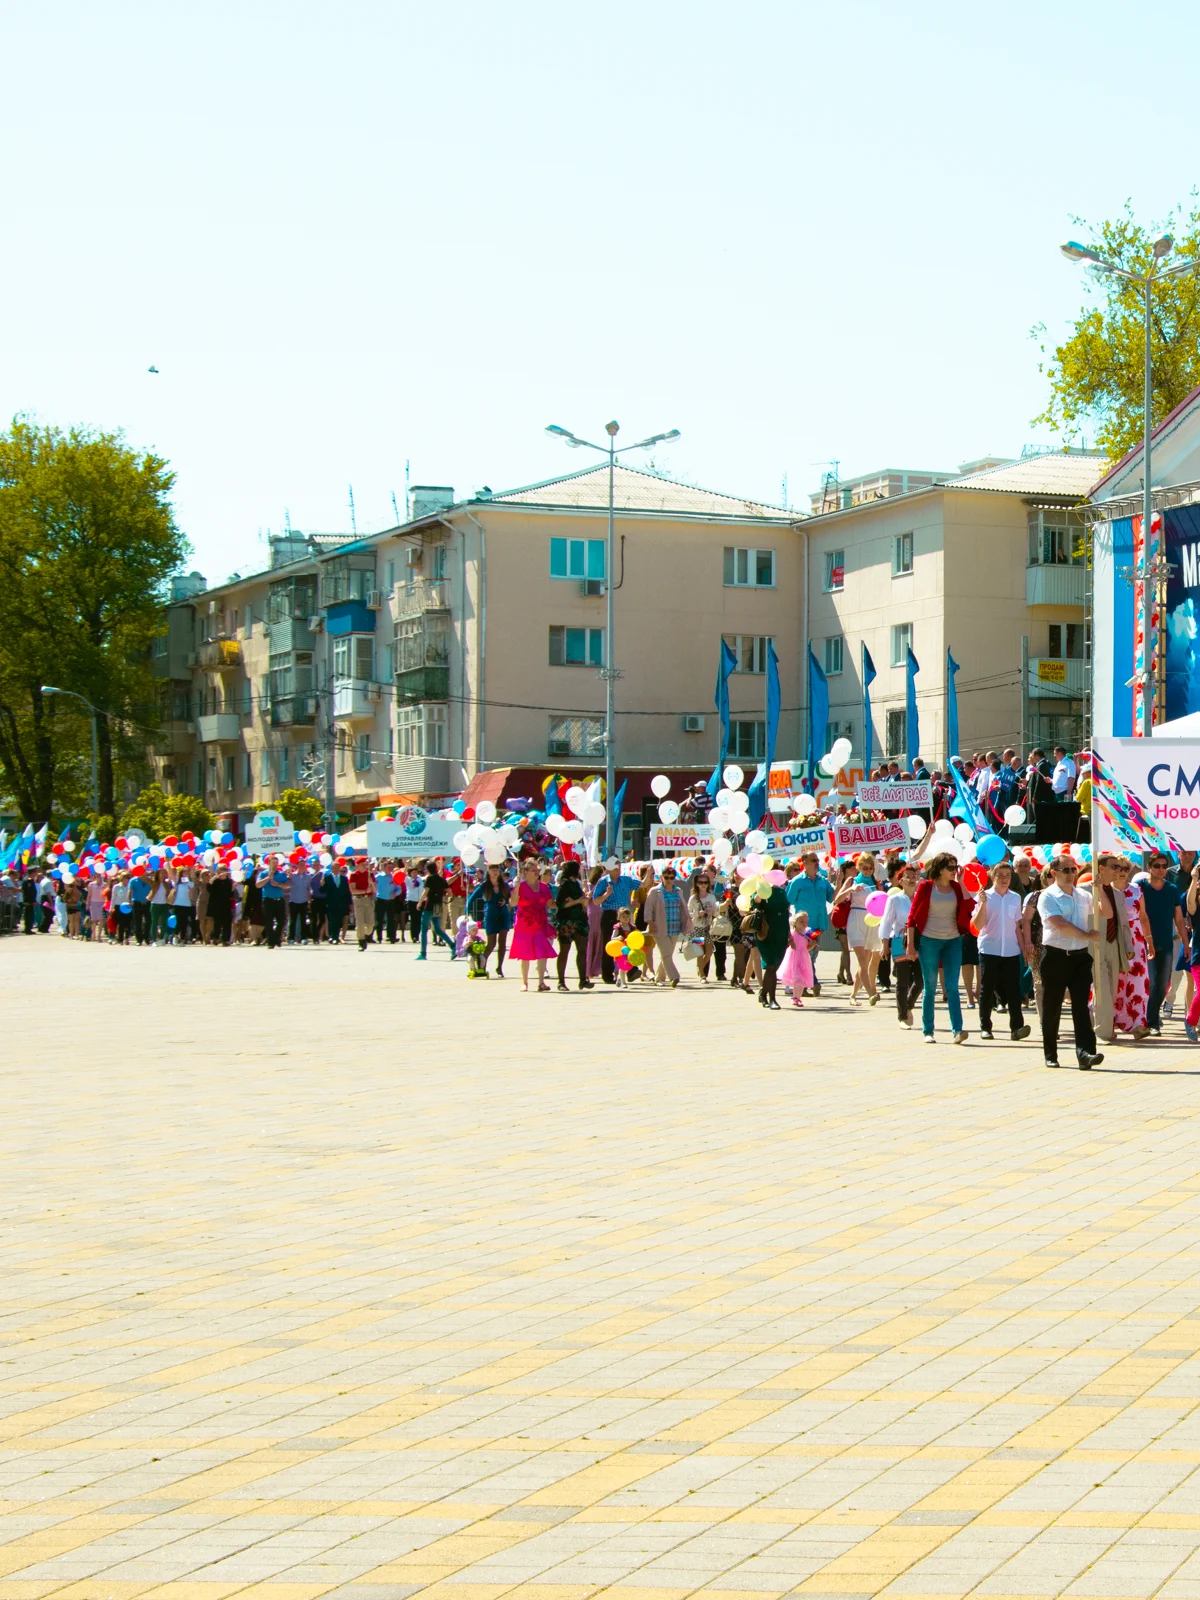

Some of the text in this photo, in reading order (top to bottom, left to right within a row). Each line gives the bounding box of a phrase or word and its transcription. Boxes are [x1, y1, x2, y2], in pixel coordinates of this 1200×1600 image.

[861, 786, 929, 803] ВСЁ ДЛЯ ВАС
[656, 827, 699, 836] ANAPA.
[767, 829, 826, 850] БЛОКНОТ
[838, 822, 906, 846] ВАША
[800, 842, 826, 853] АНАПА
